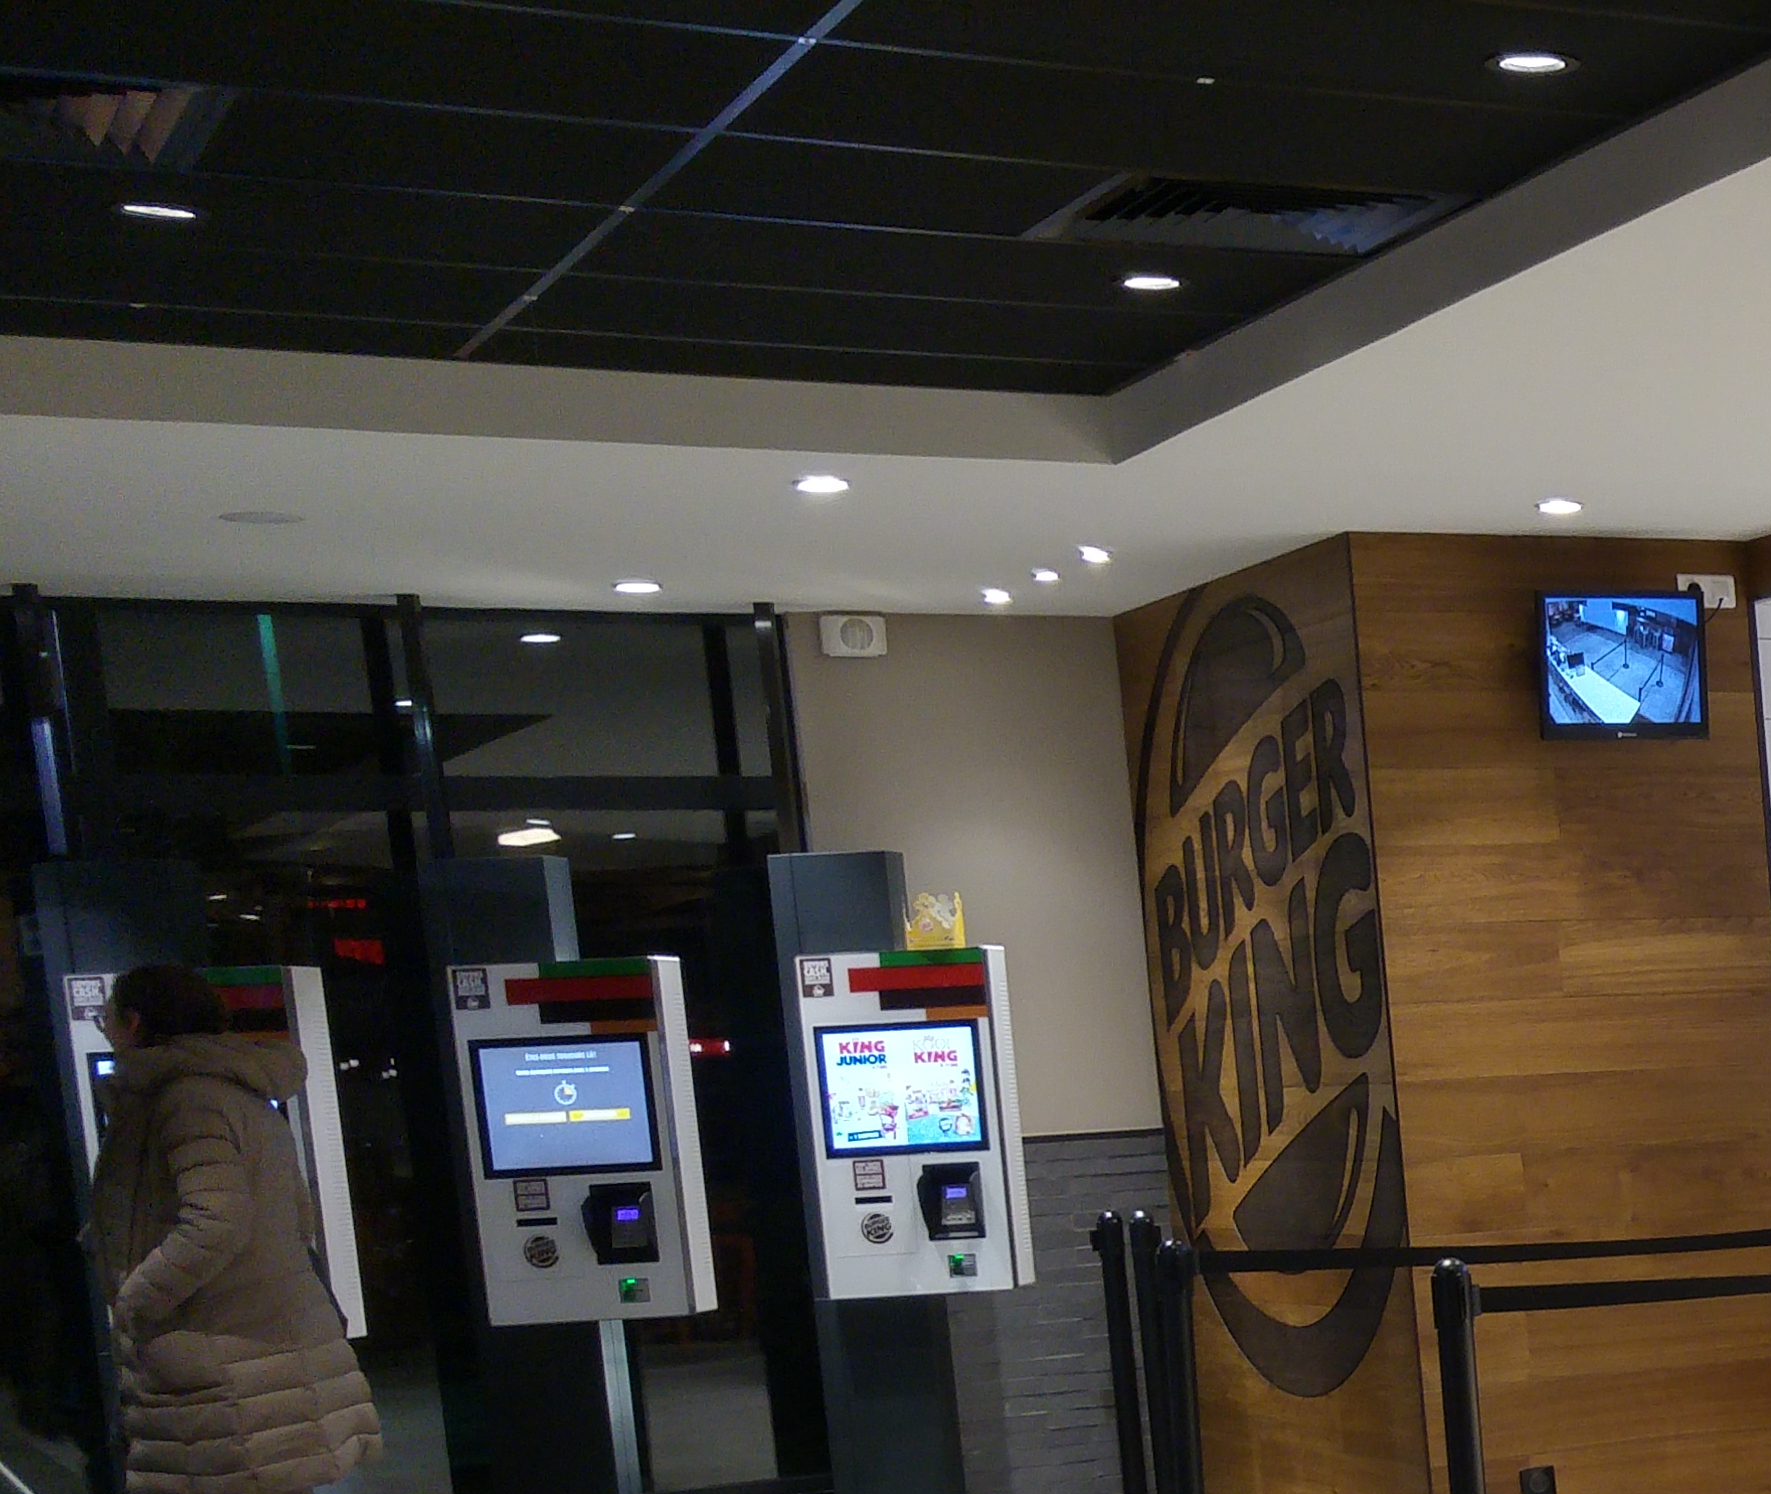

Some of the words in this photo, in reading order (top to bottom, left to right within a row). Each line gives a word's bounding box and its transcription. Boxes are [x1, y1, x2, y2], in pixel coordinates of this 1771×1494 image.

[1154, 678, 1356, 1031] BURGER
[1177, 832, 1383, 1237] KING
[838, 1040, 886, 1055] KING
[836, 1053, 888, 1067] JUNIOR
[913, 1049, 959, 1064] KING
